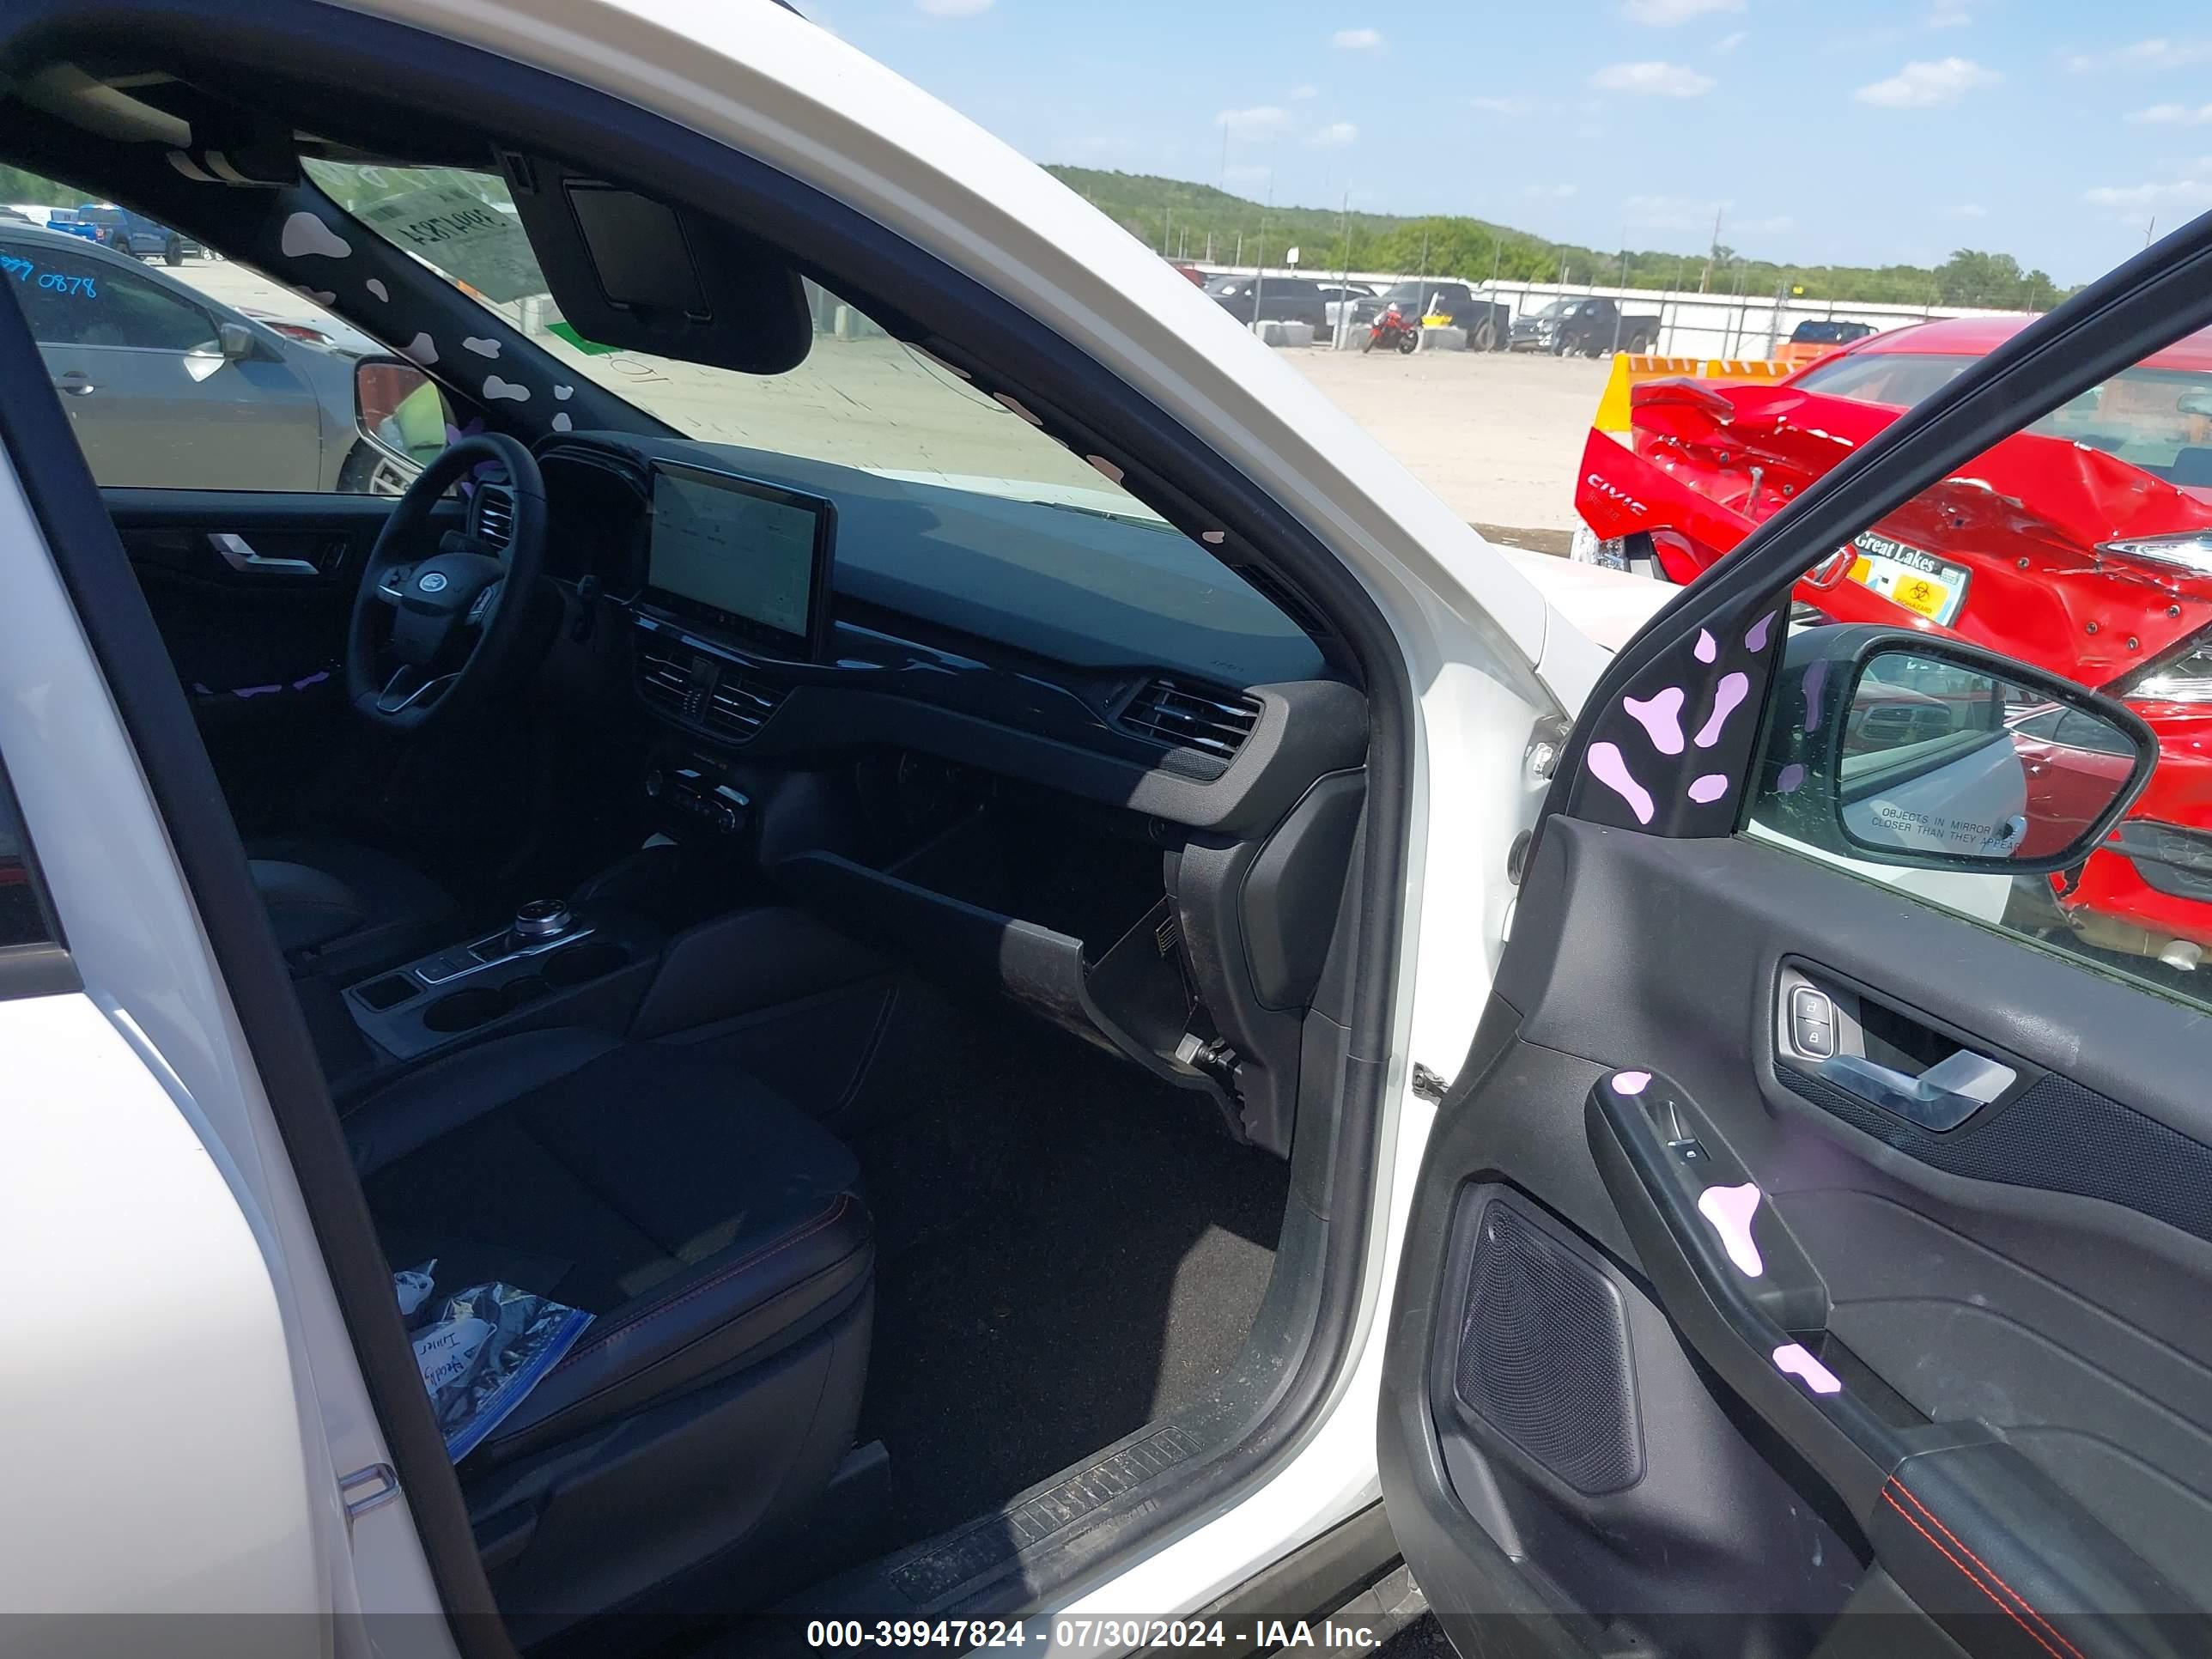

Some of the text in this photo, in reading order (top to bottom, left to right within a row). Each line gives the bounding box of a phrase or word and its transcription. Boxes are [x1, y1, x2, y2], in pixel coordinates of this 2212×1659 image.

[39, 273, 97, 299] 0878
[1587, 473, 1648, 517] CIVIC
[1854, 532, 1936, 573] Great Lakes
[1871, 817, 1912, 832] CLOSER
[1917, 826, 1945, 838] THAN
[1950, 832, 1977, 844] THEY
[1881, 807, 1929, 823] OBJECTS
[1934, 817, 1945, 827] IN
[1950, 820, 1991, 835] MIRROR
